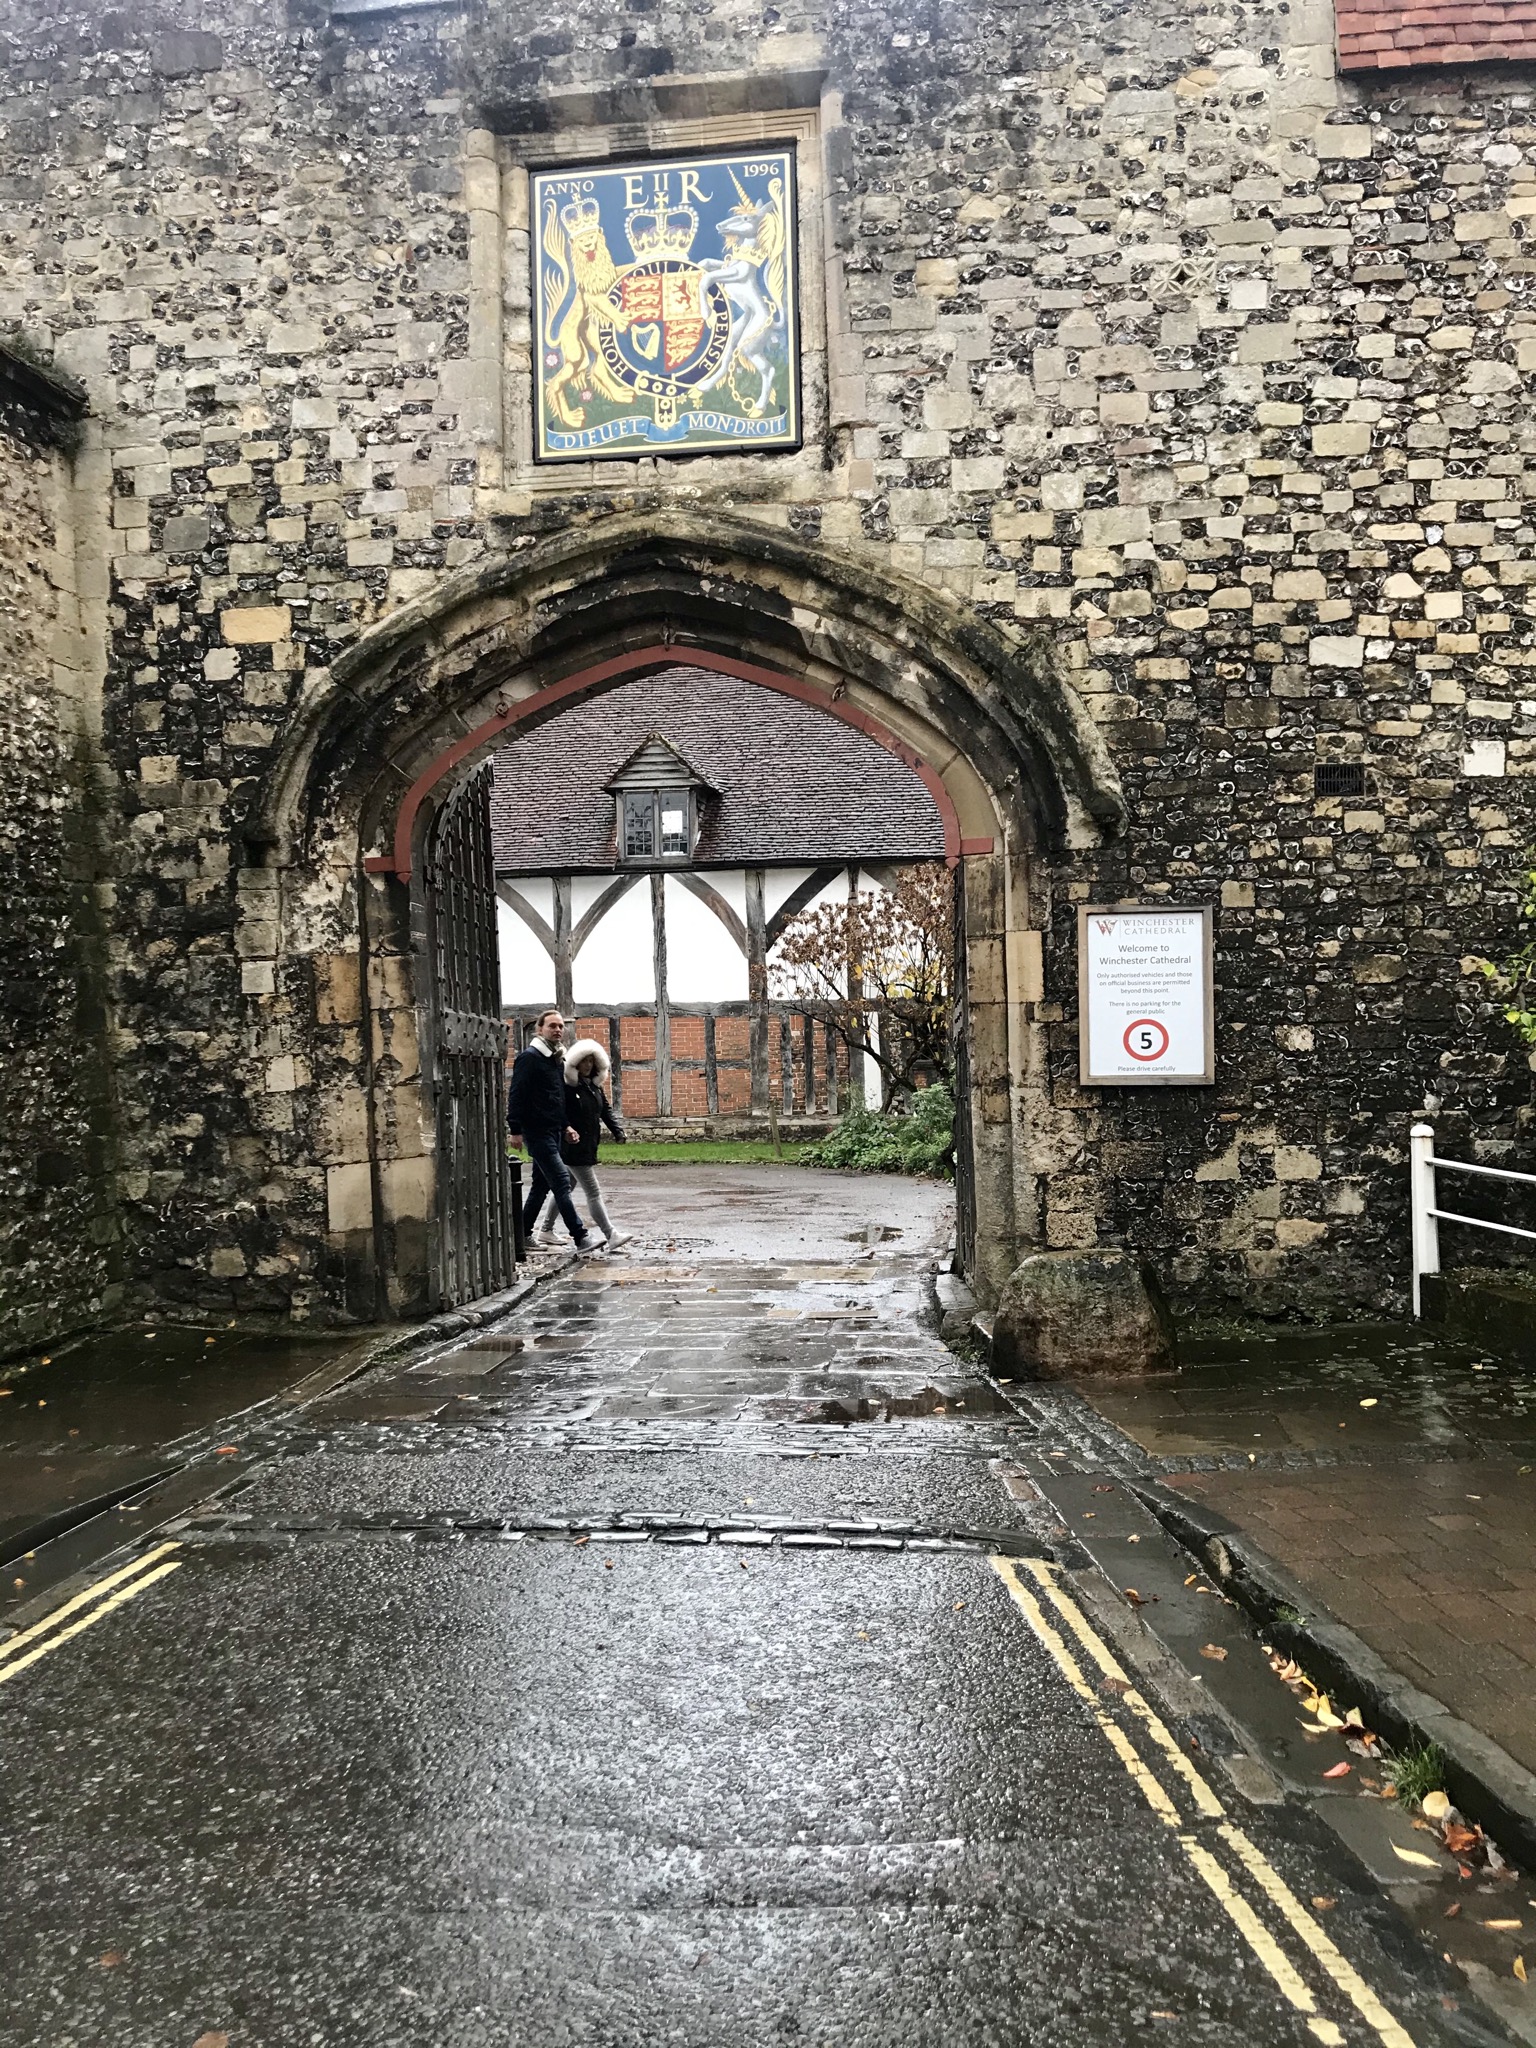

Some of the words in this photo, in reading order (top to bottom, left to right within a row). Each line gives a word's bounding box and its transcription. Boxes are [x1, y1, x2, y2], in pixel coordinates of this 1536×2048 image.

[743, 162, 780, 178] 1996
[544, 180, 595, 196] ANNO
[621, 175, 650, 210] E
[677, 170, 714, 204] R
[600, 328, 628, 377] HONI
[699, 311, 729, 371] PENSE
[1122, 918, 1195, 927] WINCHESTER
[1124, 927, 1187, 935] CATHEDRAL
[1118, 944, 1158, 953] Welcome
[1099, 956, 1148, 965] Winchester
[1149, 955, 1191, 965] Cathedral
[1110, 971, 1140, 979] authorised
[1140, 1000, 1161, 1008] parking
[1140, 1032, 1153, 1050] 5
[1151, 1065, 1176, 1073] carefully
